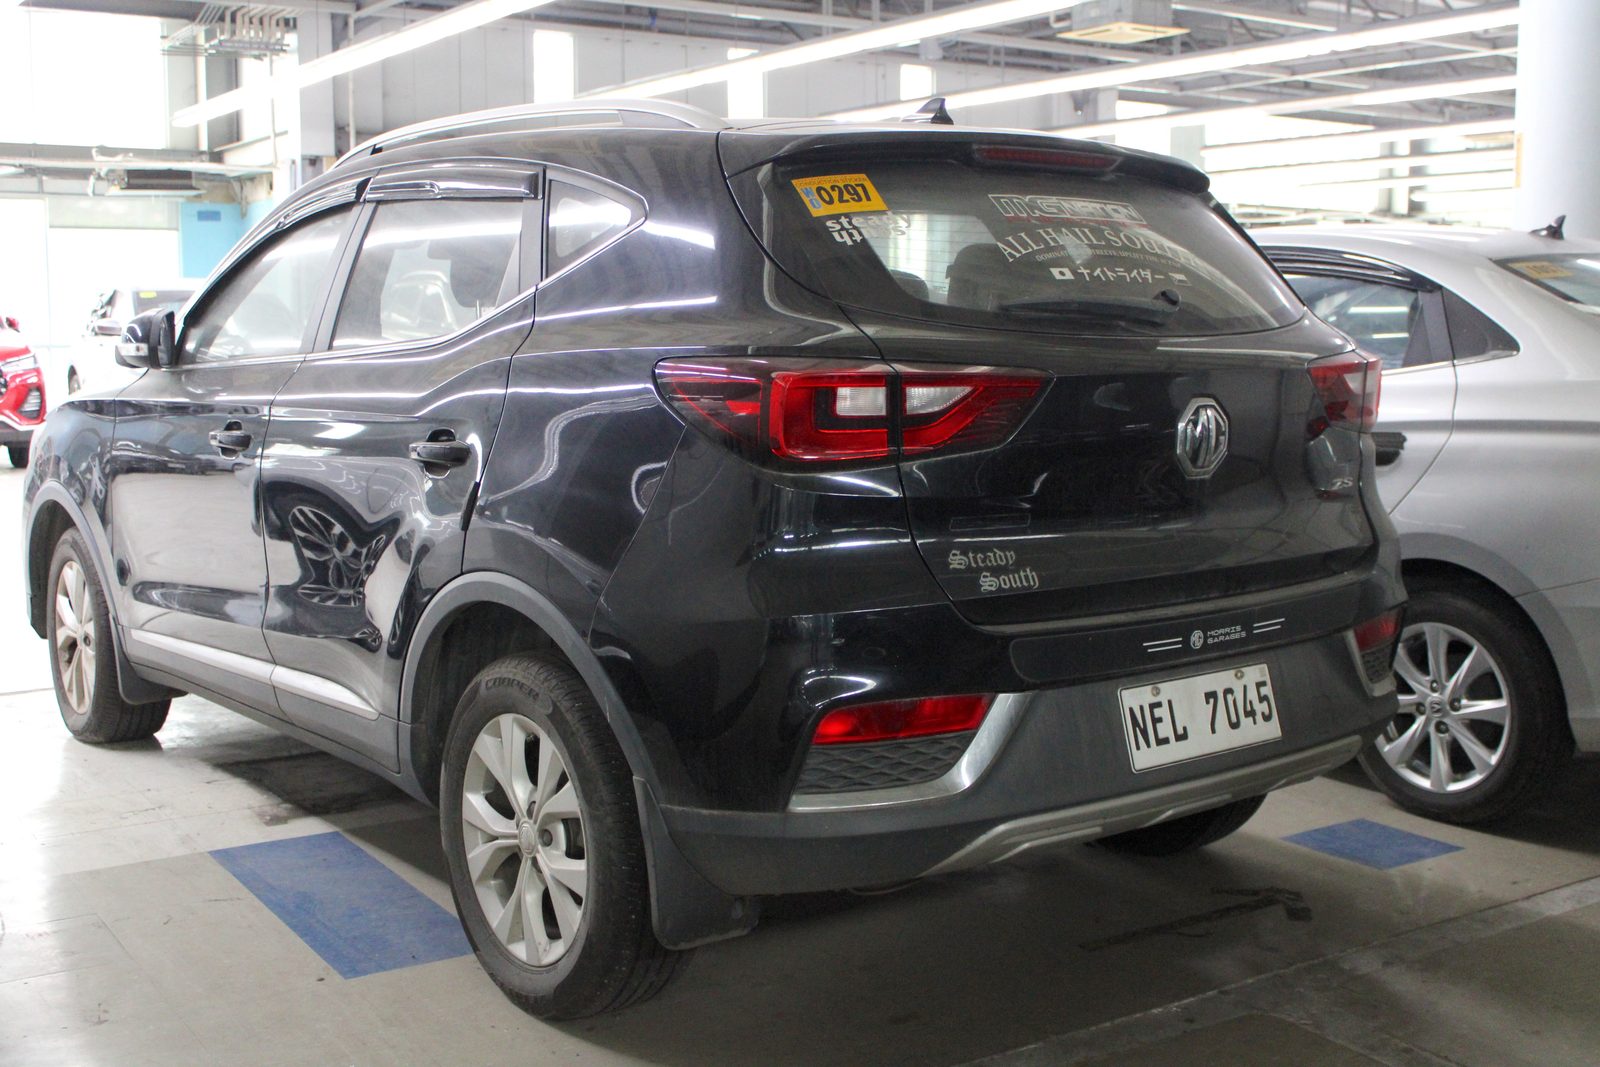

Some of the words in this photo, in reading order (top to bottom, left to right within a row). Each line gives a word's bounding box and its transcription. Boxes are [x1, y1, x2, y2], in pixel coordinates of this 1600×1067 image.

[815, 183, 872, 205] 0297
[996, 232, 1044, 262] ALL
[1038, 227, 1106, 247] HAIL
[948, 548, 1016, 569] Steady
[980, 567, 1039, 592] South
[1207, 625, 1242, 637] MORRIS
[1207, 631, 1247, 644] GARAGES
[1128, 699, 1189, 751] NEL
[1204, 680, 1273, 734] 7045
